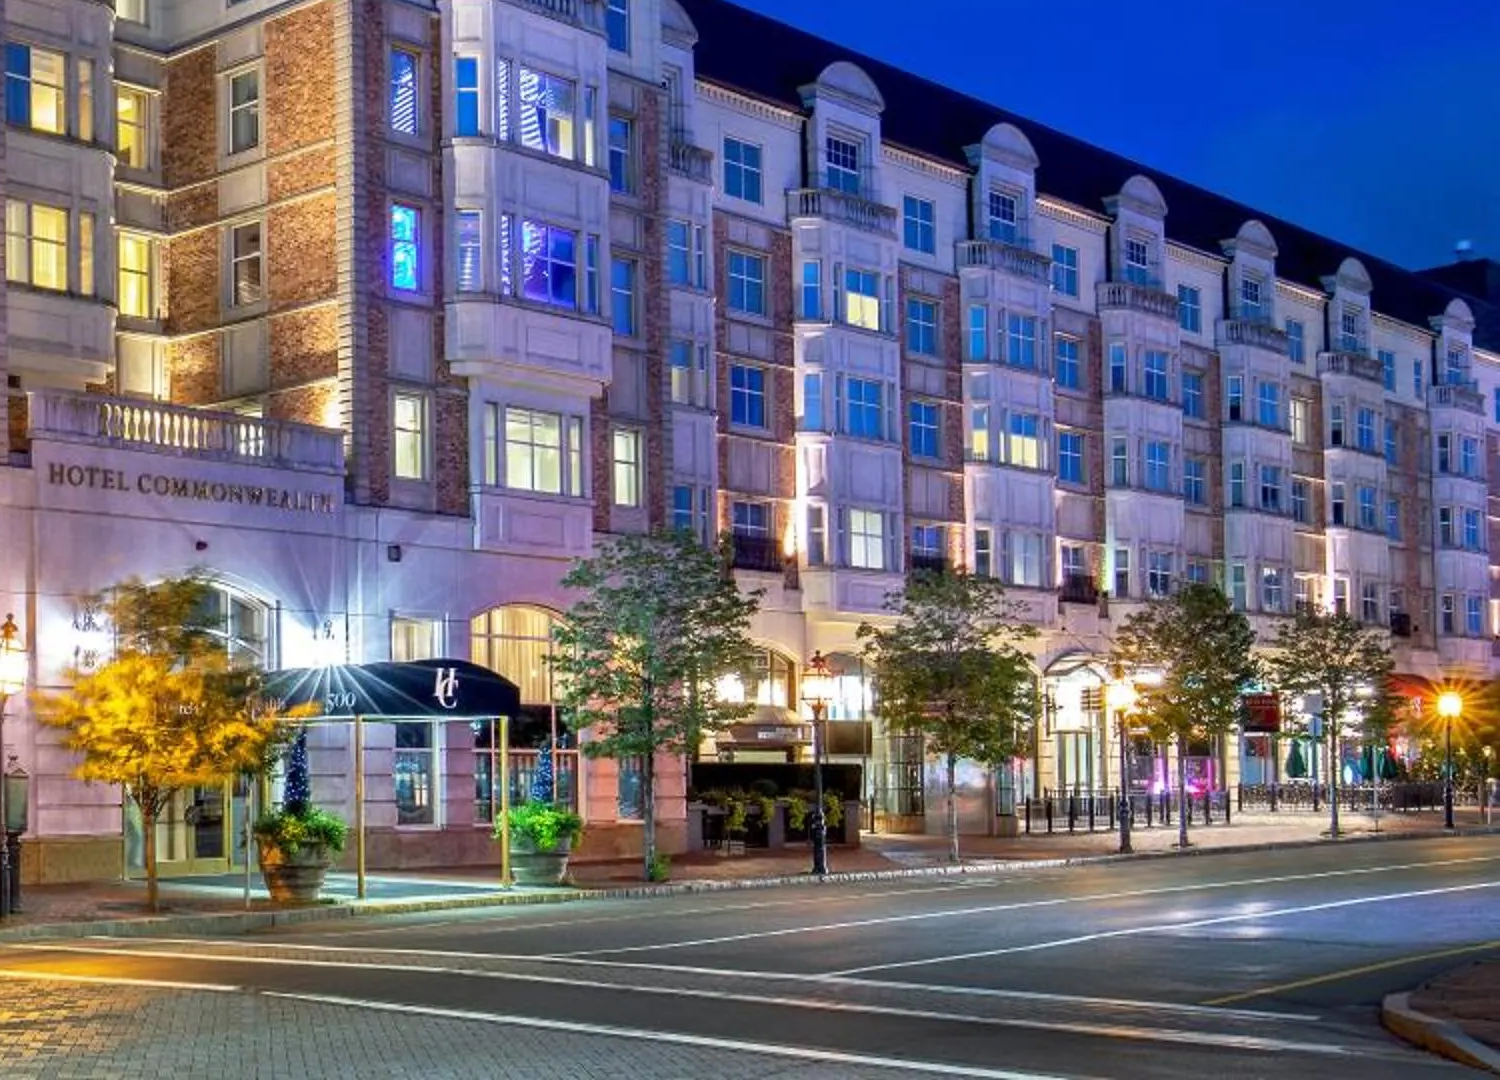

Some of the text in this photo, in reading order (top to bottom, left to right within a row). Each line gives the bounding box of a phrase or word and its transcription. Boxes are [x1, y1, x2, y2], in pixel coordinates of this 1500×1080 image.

[49, 463, 334, 513] HOTEL COMMONWEALTH
[326, 691, 355, 711] 500
